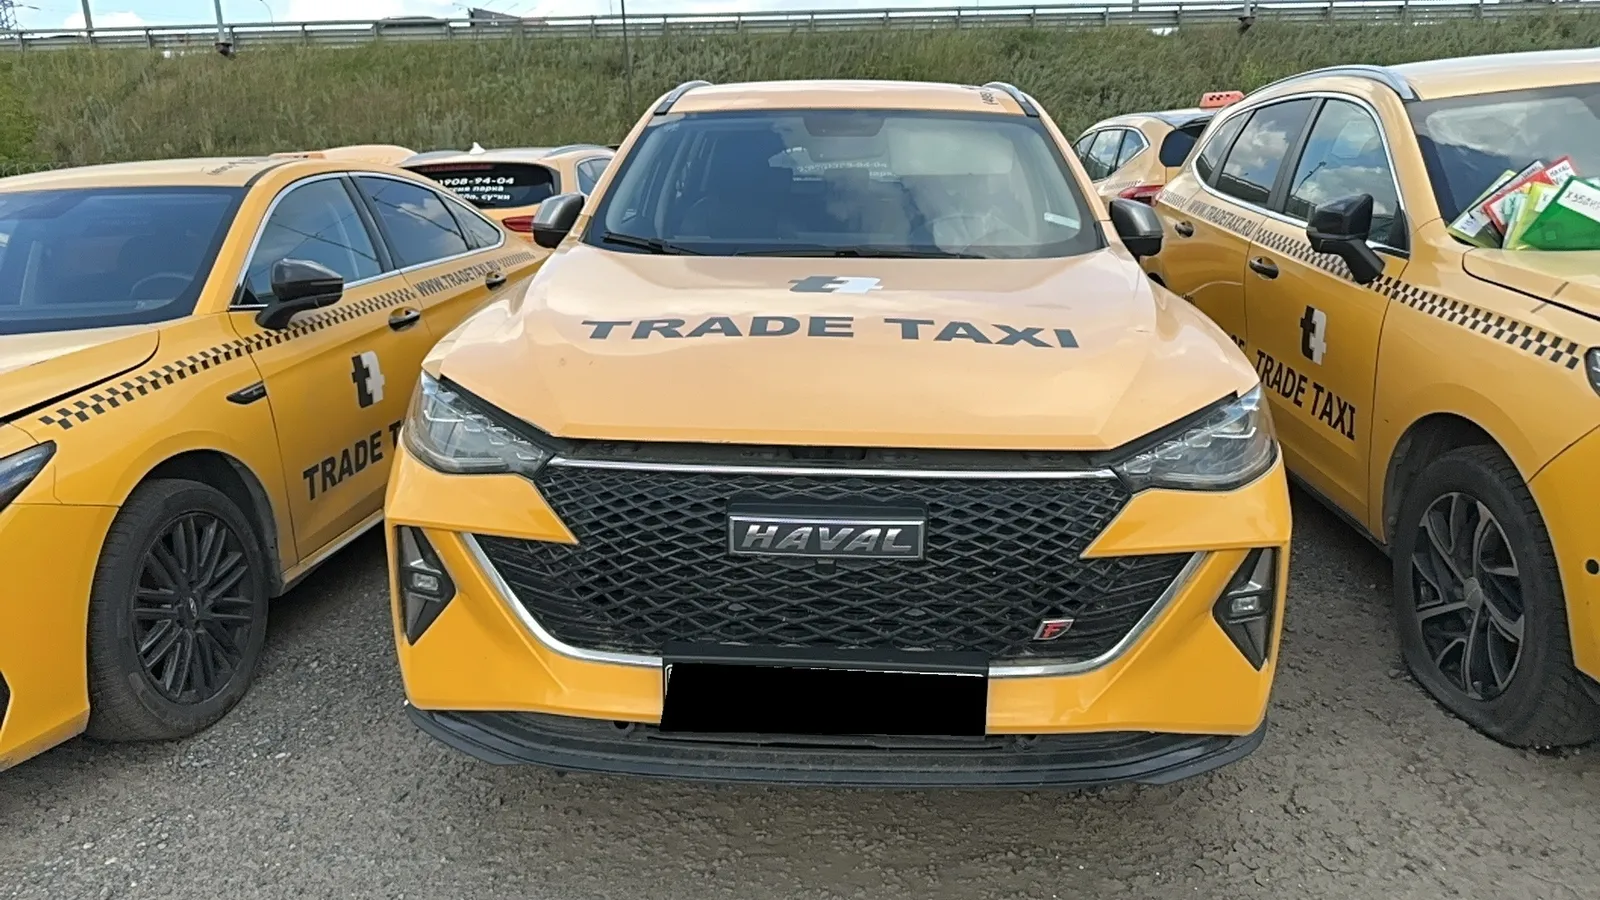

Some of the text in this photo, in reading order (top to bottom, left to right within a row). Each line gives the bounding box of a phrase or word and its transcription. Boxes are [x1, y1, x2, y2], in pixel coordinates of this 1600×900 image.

[581, 316, 1080, 348] TRADE TAXI
[1255, 349, 1356, 442] TRADE TAXI
[302, 430, 384, 501] TRADE
[740, 524, 912, 552] HAVAL
